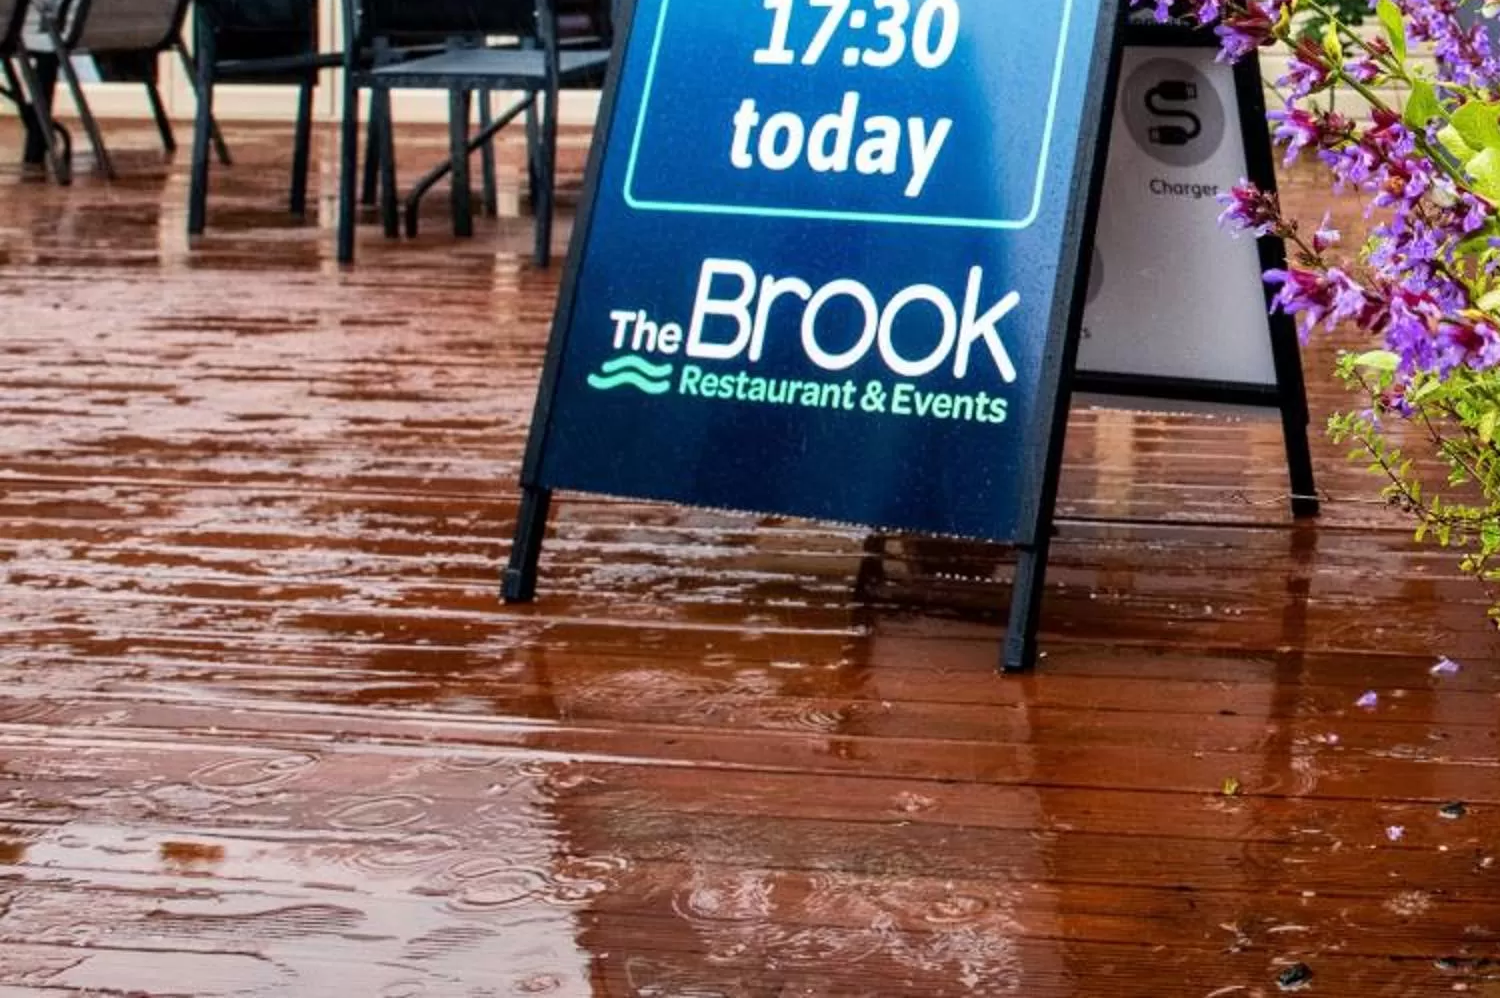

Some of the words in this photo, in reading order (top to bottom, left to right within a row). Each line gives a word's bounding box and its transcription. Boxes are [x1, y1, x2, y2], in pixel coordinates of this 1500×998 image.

[730, 90, 953, 197] today
[1149, 178, 1219, 199] Charger
[610, 309, 683, 354] The
[685, 257, 1020, 383] Brook
[678, 365, 855, 410] Restaurant
[860, 381, 885, 412] &
[891, 383, 1007, 423] Events
